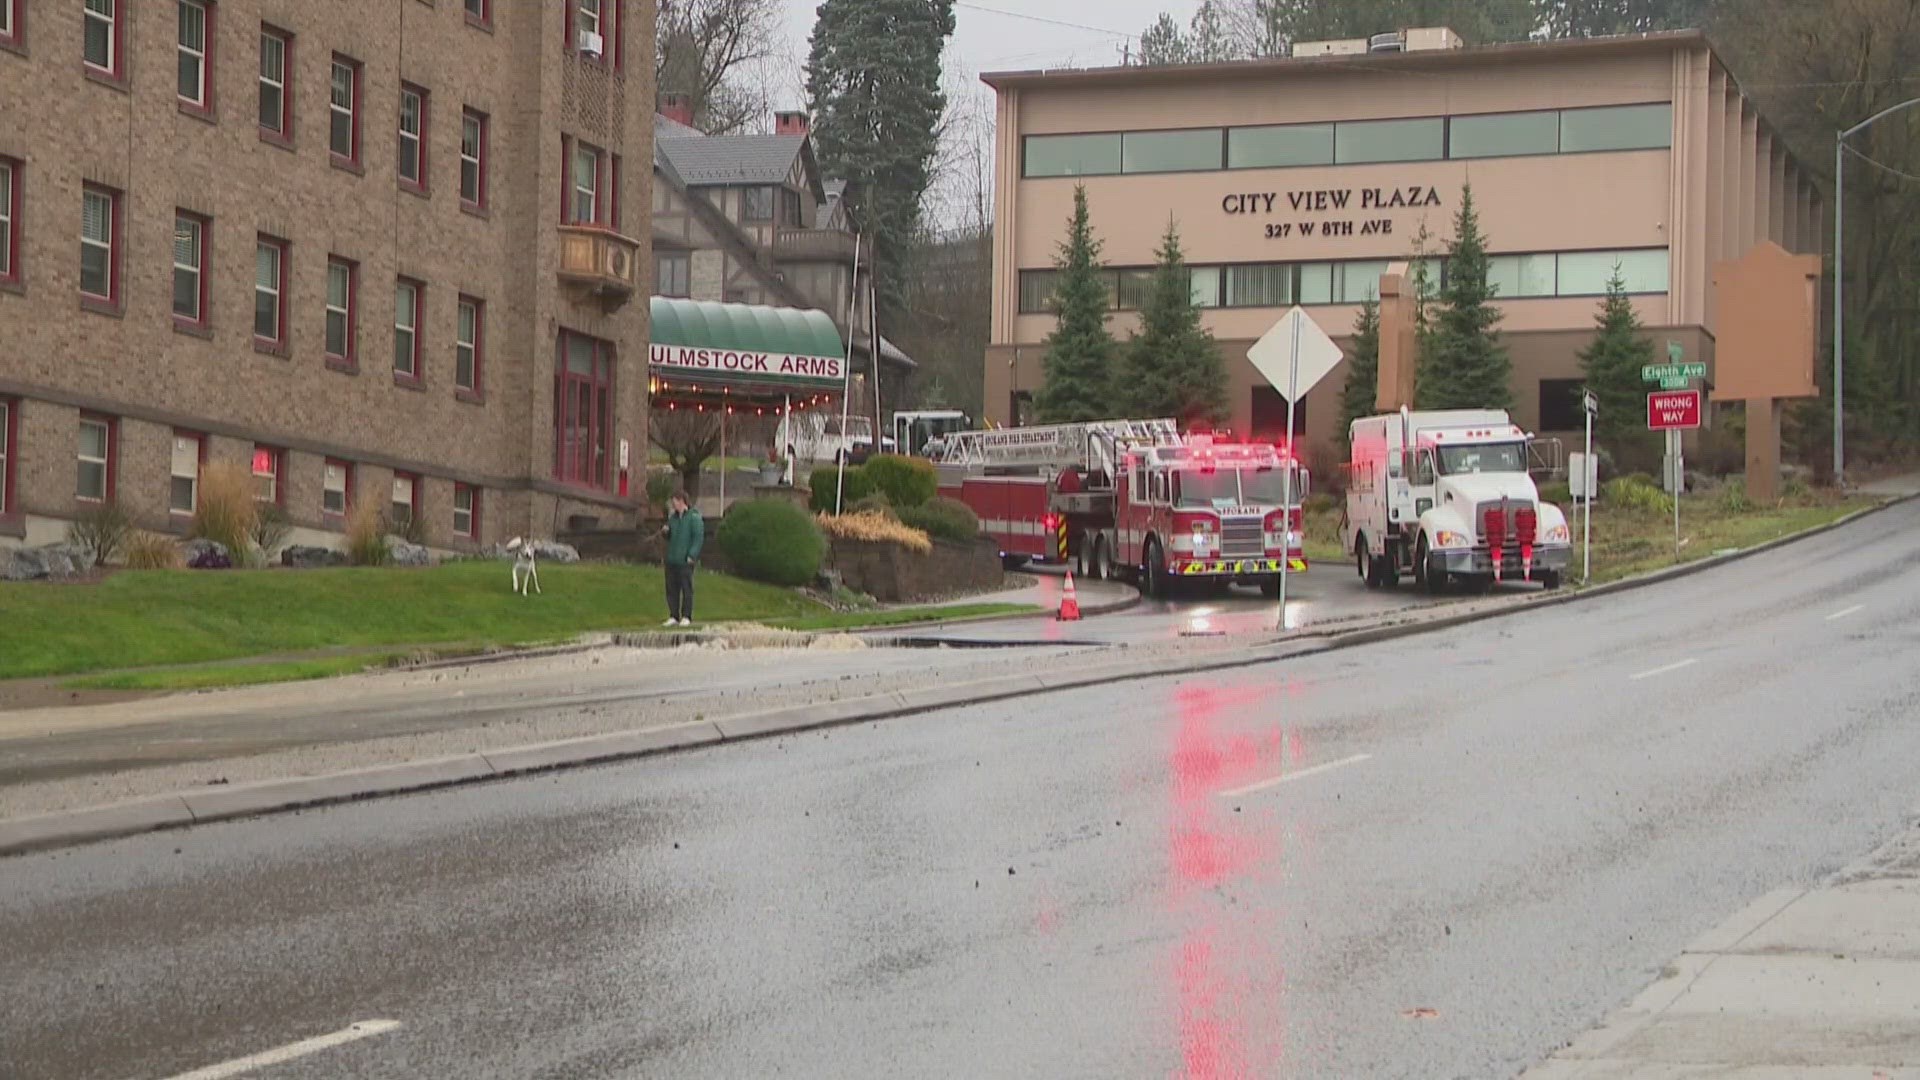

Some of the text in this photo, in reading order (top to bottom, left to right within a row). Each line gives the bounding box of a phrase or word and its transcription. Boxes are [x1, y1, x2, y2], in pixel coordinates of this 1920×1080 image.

[1222, 186, 1441, 214] CITY VIEW PLAZA
[1265, 219, 1392, 239] 327 W 8TH AVE
[651, 345, 840, 377] ULMSTOCK ARMS
[1645, 364, 1702, 379] Eighth Ave
[1655, 398, 1692, 410] WRONG
[1662, 410, 1685, 423] WAY
